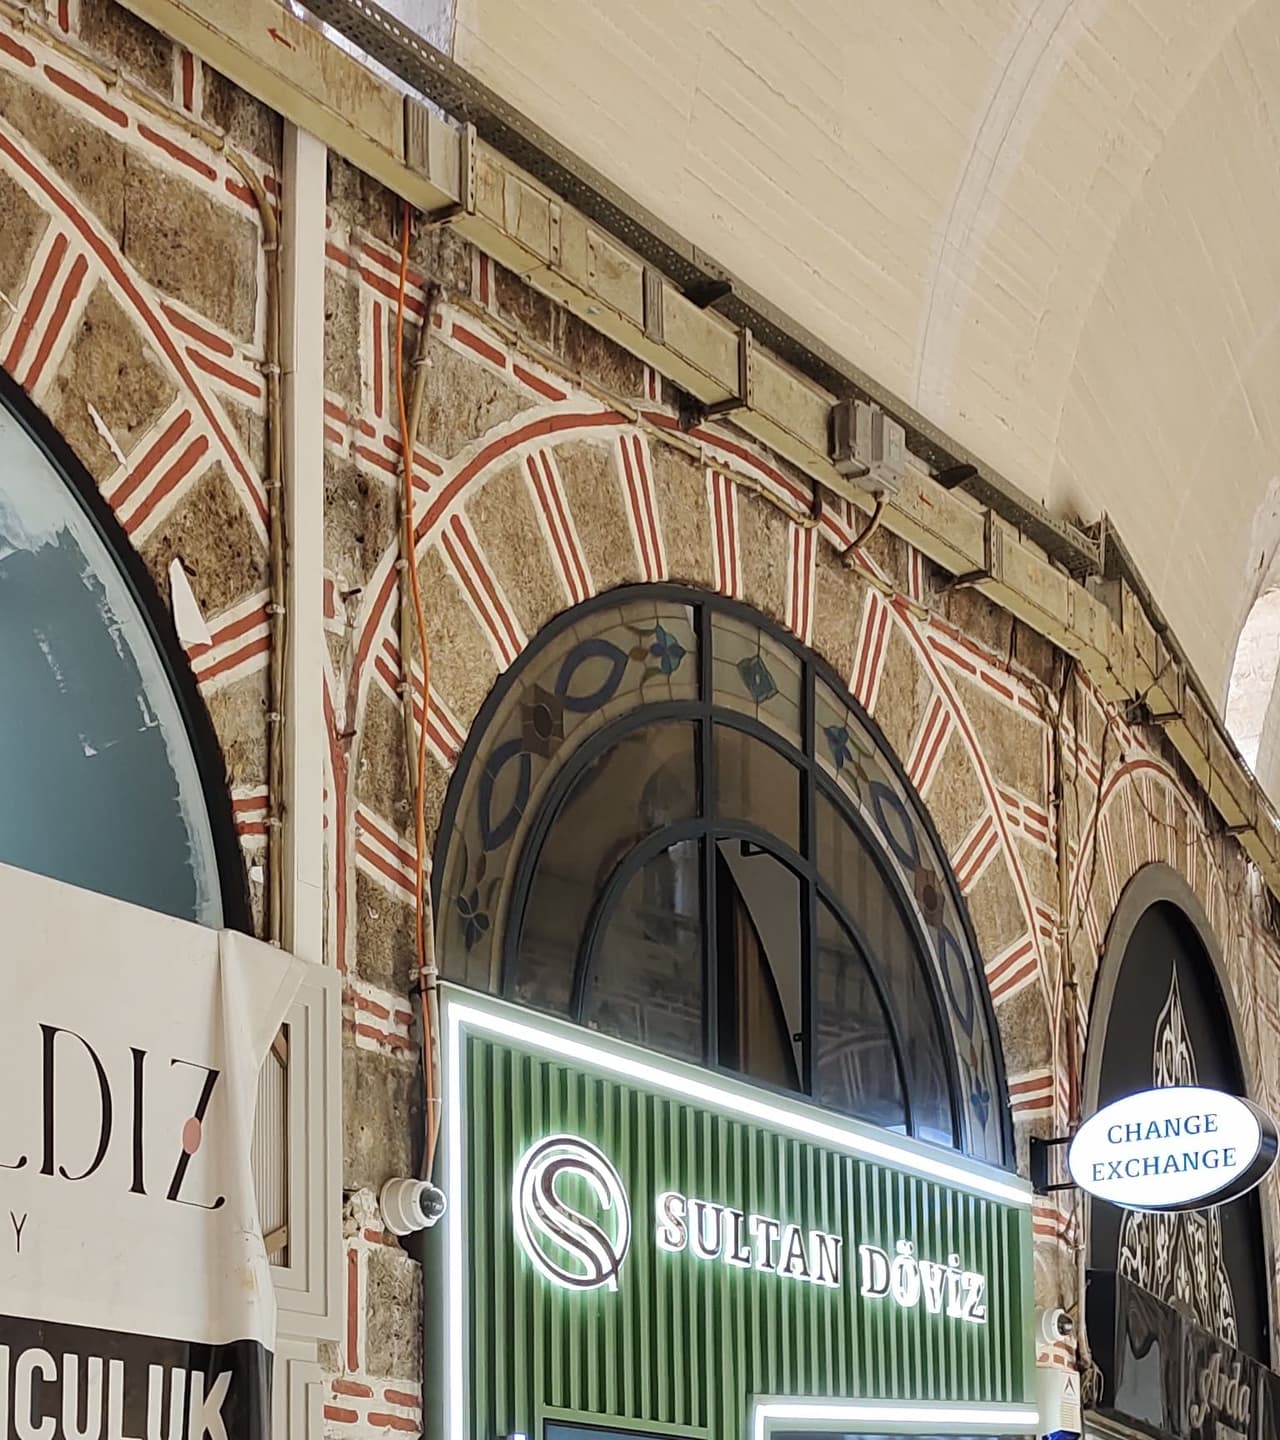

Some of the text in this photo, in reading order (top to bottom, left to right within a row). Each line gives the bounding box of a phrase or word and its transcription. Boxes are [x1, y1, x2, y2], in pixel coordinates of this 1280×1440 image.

[1107, 1113, 1219, 1144] CHANGE
[1092, 1148, 1237, 1182] EXCHANGE
[656, 1191, 988, 1324] SULTAN DÖVİZ
